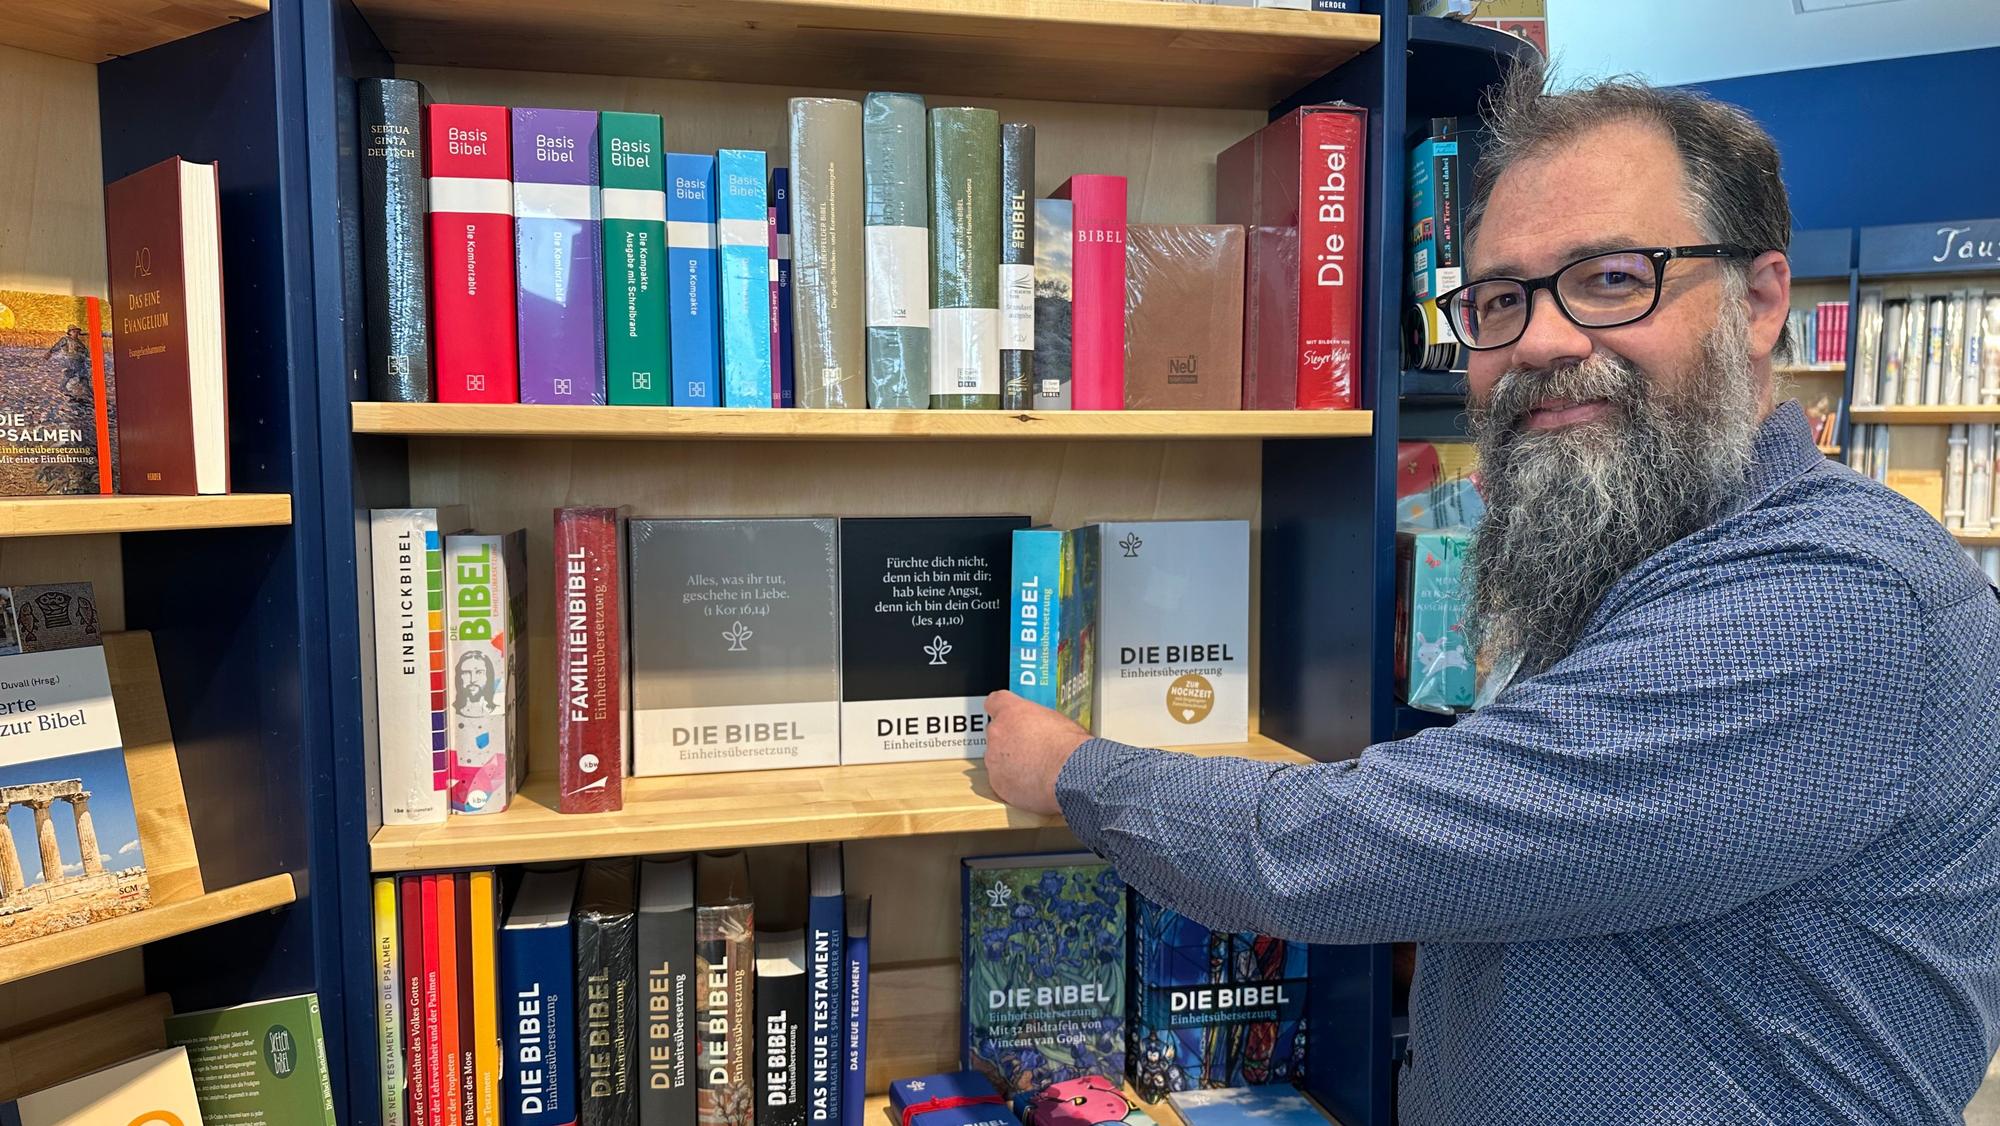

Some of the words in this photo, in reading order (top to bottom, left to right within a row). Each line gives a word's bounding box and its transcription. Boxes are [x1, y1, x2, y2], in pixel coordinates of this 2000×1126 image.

[1319, 1, 1347, 9] HERDER
[371, 125, 410, 135] SEPTUA
[449, 128, 487, 141] Basis
[374, 137, 407, 146] GINTA
[449, 142, 487, 155] Bibel
[536, 135, 574, 148] Basis
[611, 138, 651, 153] Basis
[368, 148, 415, 158] DEUTSCH
[536, 149, 574, 163] Bibel
[611, 153, 651, 168] Bibel
[676, 177, 706, 189] Basis
[729, 175, 758, 186] Basis
[730, 185, 758, 197] Bibel
[1319, 144, 1346, 223] Bibel
[677, 188, 705, 200] Bibel
[1012, 189, 1026, 241] BIBEL
[466, 224, 476, 240] Die
[639, 232, 648, 247] Die
[1077, 229, 1123, 244] BIBEL
[625, 231, 635, 268] Ausgabe
[1933, 227, 2000, 262] Tau
[467, 241, 477, 296] Komfortable
[689, 259, 697, 273] Die
[1318, 234, 1344, 287] Die
[627, 270, 636, 284] mit
[129, 294, 143, 310] DAS
[144, 290, 161, 307] EINE
[689, 274, 698, 316] Kompakte
[627, 286, 638, 337] Schreibrand
[124, 312, 169, 334] EVANGELIUM
[1169, 355, 1197, 374] NeÜ
[15, 456, 39, 464] einer
[41, 454, 95, 465] Einführung
[886, 556, 929, 568] Fürchte
[931, 556, 955, 567] dich
[957, 556, 988, 568] nicht,
[686, 574, 719, 587] Alles,
[721, 576, 744, 585] was
[747, 573, 762, 585] ihr
[765, 574, 786, 586] tut,
[882, 571, 911, 583] denn
[913, 571, 930, 582] ich
[933, 570, 951, 582] bin
[953, 570, 971, 581] mit
[457, 544, 492, 641] BIBEL
[682, 588, 738, 604] geschehe
[740, 588, 752, 600] in
[754, 588, 790, 600] Liebe.
[892, 586, 914, 598] hab
[916, 585, 946, 597] keine
[948, 585, 983, 598] Angst,
[399, 530, 415, 675] EINBLICKBIBEL
[715, 604, 737, 616] Kor
[874, 601, 903, 613] denn
[905, 600, 922, 612] ich
[924, 600, 942, 611] bin
[945, 599, 969, 610] dein
[970, 599, 1000, 610] Gott!
[1021, 575, 1039, 643] BIBEL
[911, 615, 933, 627] (Jes
[450, 625, 458, 641] DIE
[567, 546, 589, 722] FAMILIENBIBEL
[1039, 588, 1053, 686] Einheitsübersetzung
[592, 583, 608, 721] Einheitsübersetzung
[1120, 646, 1160, 665] DIE
[1166, 644, 1234, 663] BIBEL
[1020, 647, 1038, 686] DIE
[1120, 666, 1223, 679] Einheitsübersetzung
[1, 680, 30, 690] Duvall
[31, 675, 60, 687] (Hrsg.)
[1171, 686, 1213, 699] HOCHZEIT
[1186, 680, 1200, 689] ZUR
[0, 720, 32, 737] zur
[37, 709, 87, 731] Bibel
[877, 717, 919, 737] DIE
[926, 714, 991, 734] BIBE
[672, 726, 718, 747] DIE
[725, 721, 805, 744] BIBEL
[883, 737, 987, 751] Einheitsübersetzun
[679, 745, 799, 761] Einheitsübersetzung
[119, 884, 138, 895] SCM
[831, 929, 840, 949] ZEIT
[382, 937, 391, 981] PSALMEN
[813, 929, 829, 1033] TESTAMENT
[830, 953, 839, 990] UNSERER
[383, 984, 392, 1000] DIE
[410, 976, 419, 1006] Gottes
[426, 971, 437, 1008] Psalmen
[708, 956, 728, 1034] BIBEL
[850, 960, 861, 1018] TESTAMENT
[989, 988, 1030, 1009] DIE
[1037, 983, 1111, 1007] BIBEL
[1170, 990, 1213, 1012] DIE
[1218, 985, 1290, 1008] BIBEL
[588, 967, 610, 1047] BIBEL
[649, 961, 669, 1039] BIBEL
[830, 990, 839, 1031] SPRACHE
[384, 1003, 393, 1023] UND
[411, 1007, 420, 1036] Volkes
[427, 1008, 437, 1023] der
[518, 982, 541, 1063] BIBEL
[989, 1007, 1097, 1022] Einheitsübersetzung
[1170, 1009, 1278, 1025] Einheitsübersetzung
[428, 1024, 438, 1042] und
[674, 973, 687, 1088] Einheitsübersetzung
[733, 969, 745, 1084] Einheitsübersetzung
[850, 1020, 860, 1048] NEUE
[989, 1025, 1009, 1036] Mit
[1025, 1020, 1079, 1034] Bildtafeln
[1081, 1020, 1102, 1029] von
[412, 1037, 421, 1052] des
[614, 979, 627, 1096] Einheitsübersetzung
[767, 1010, 787, 1068] BIBEL
[830, 1033, 839, 1048] DIE
[989, 1037, 1031, 1049] Vincent
[1034, 1037, 1054, 1046] van
[1056, 1033, 1087, 1046] Gogh
[385, 1026, 395, 1081] TESTAMENT
[463, 1051, 473, 1074] Mose
[545, 994, 558, 1111] Einheitsübersetzung
[709, 1040, 729, 1084] DIE
[814, 1036, 828, 1082] NEUE
[850, 1050, 859, 1071] DAS
[428, 1043, 440, 1098] Lehrweisheit
[650, 1046, 670, 1090] DIE
[788, 1024, 799, 1104] Einheitsübersetzung
[412, 1053, 423, 1100] Geschichte
[446, 1053, 457, 1097] Propheten
[463, 1075, 473, 1090] des
[590, 1052, 612, 1098] DIE
[322, 1081, 331, 1098] Bibel
[387, 1084, 396, 1109] NEUE
[521, 1069, 543, 1114] DIE
[767, 1070, 788, 1106] DIE
[829, 1062, 838, 1119] ÜBERTRAGEN
[415, 1101, 423, 1116] der
[431, 1098, 441, 1113] der
[463, 1091, 475, 1121] Bücher
[813, 1089, 827, 1120] DAS
